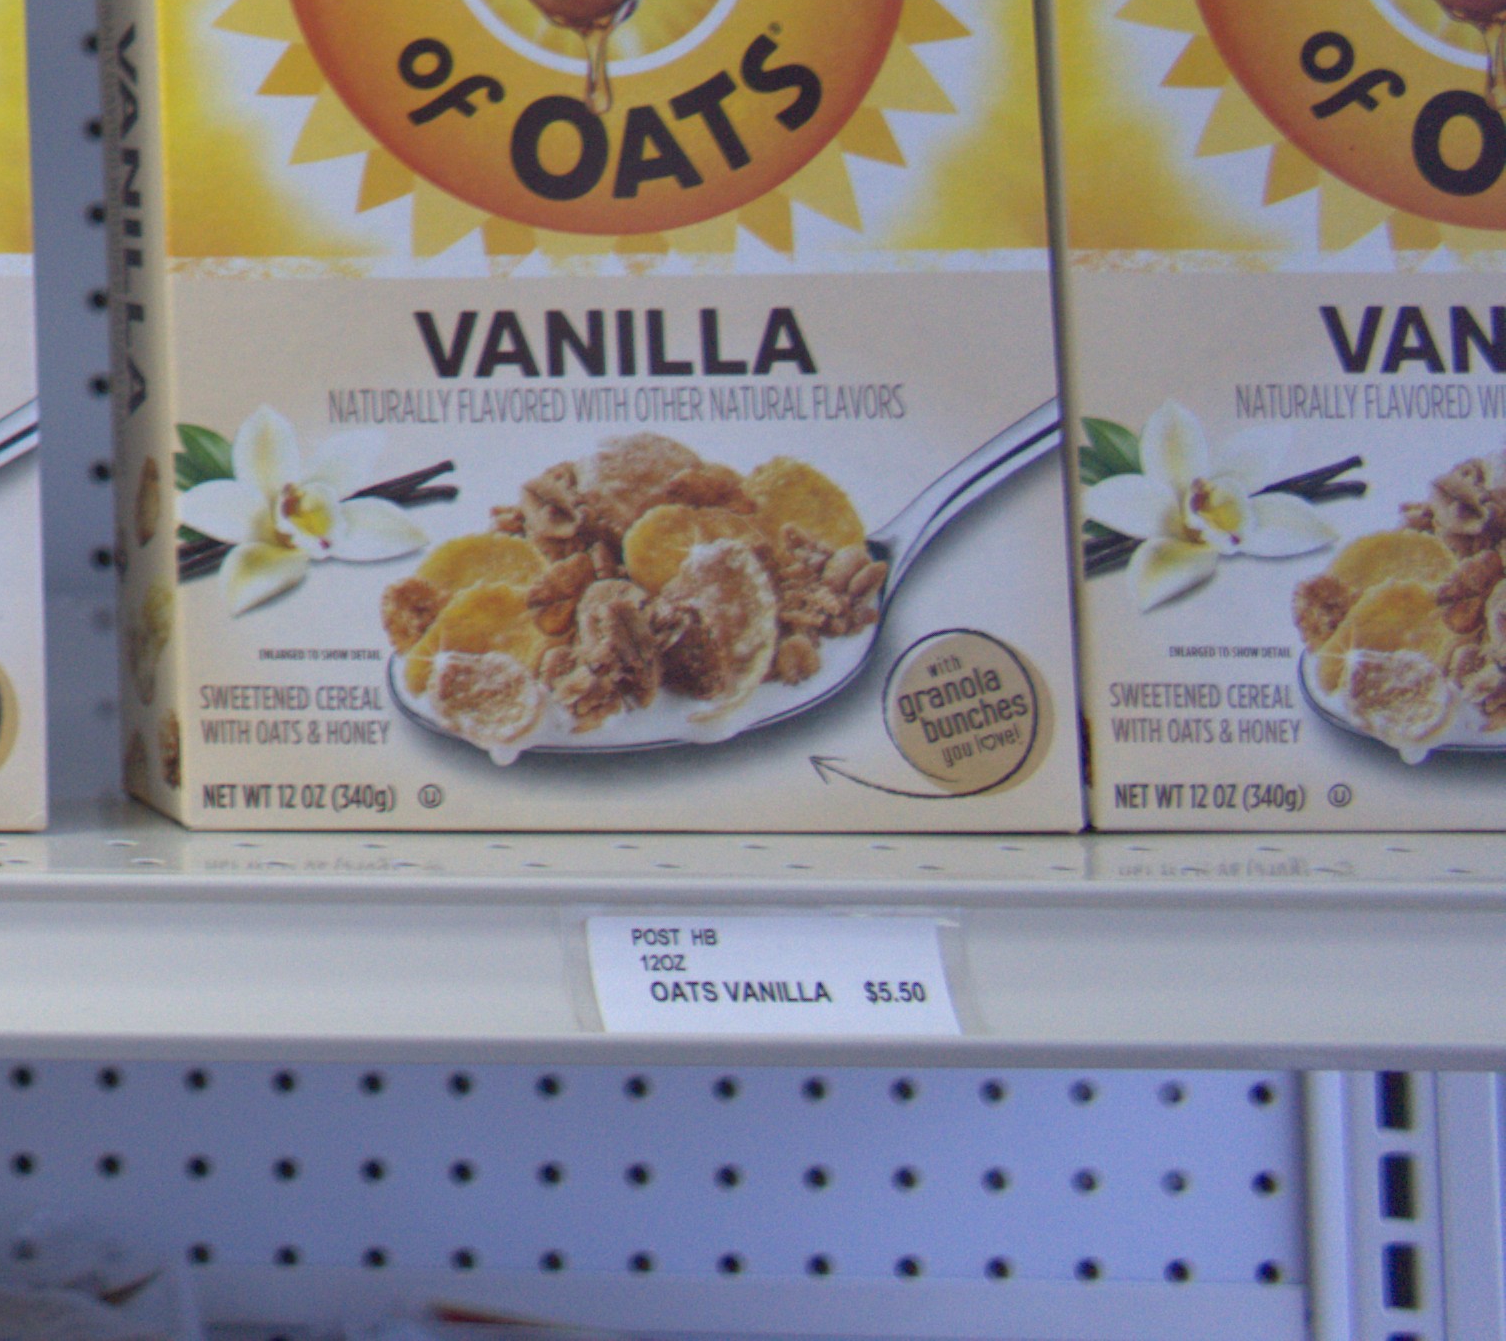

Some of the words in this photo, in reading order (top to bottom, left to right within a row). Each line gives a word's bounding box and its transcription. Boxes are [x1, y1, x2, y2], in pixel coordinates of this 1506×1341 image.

[509, 32, 824, 202] OATS
[414, 307, 818, 379] VANILLA
[631, 928, 681, 946] POST
[691, 929, 718, 946] HB
[640, 954, 687, 972] 12OZ
[650, 980, 719, 1003] OATS
[723, 980, 833, 1004] VANILLA
[863, 980, 927, 1006] $5.50
